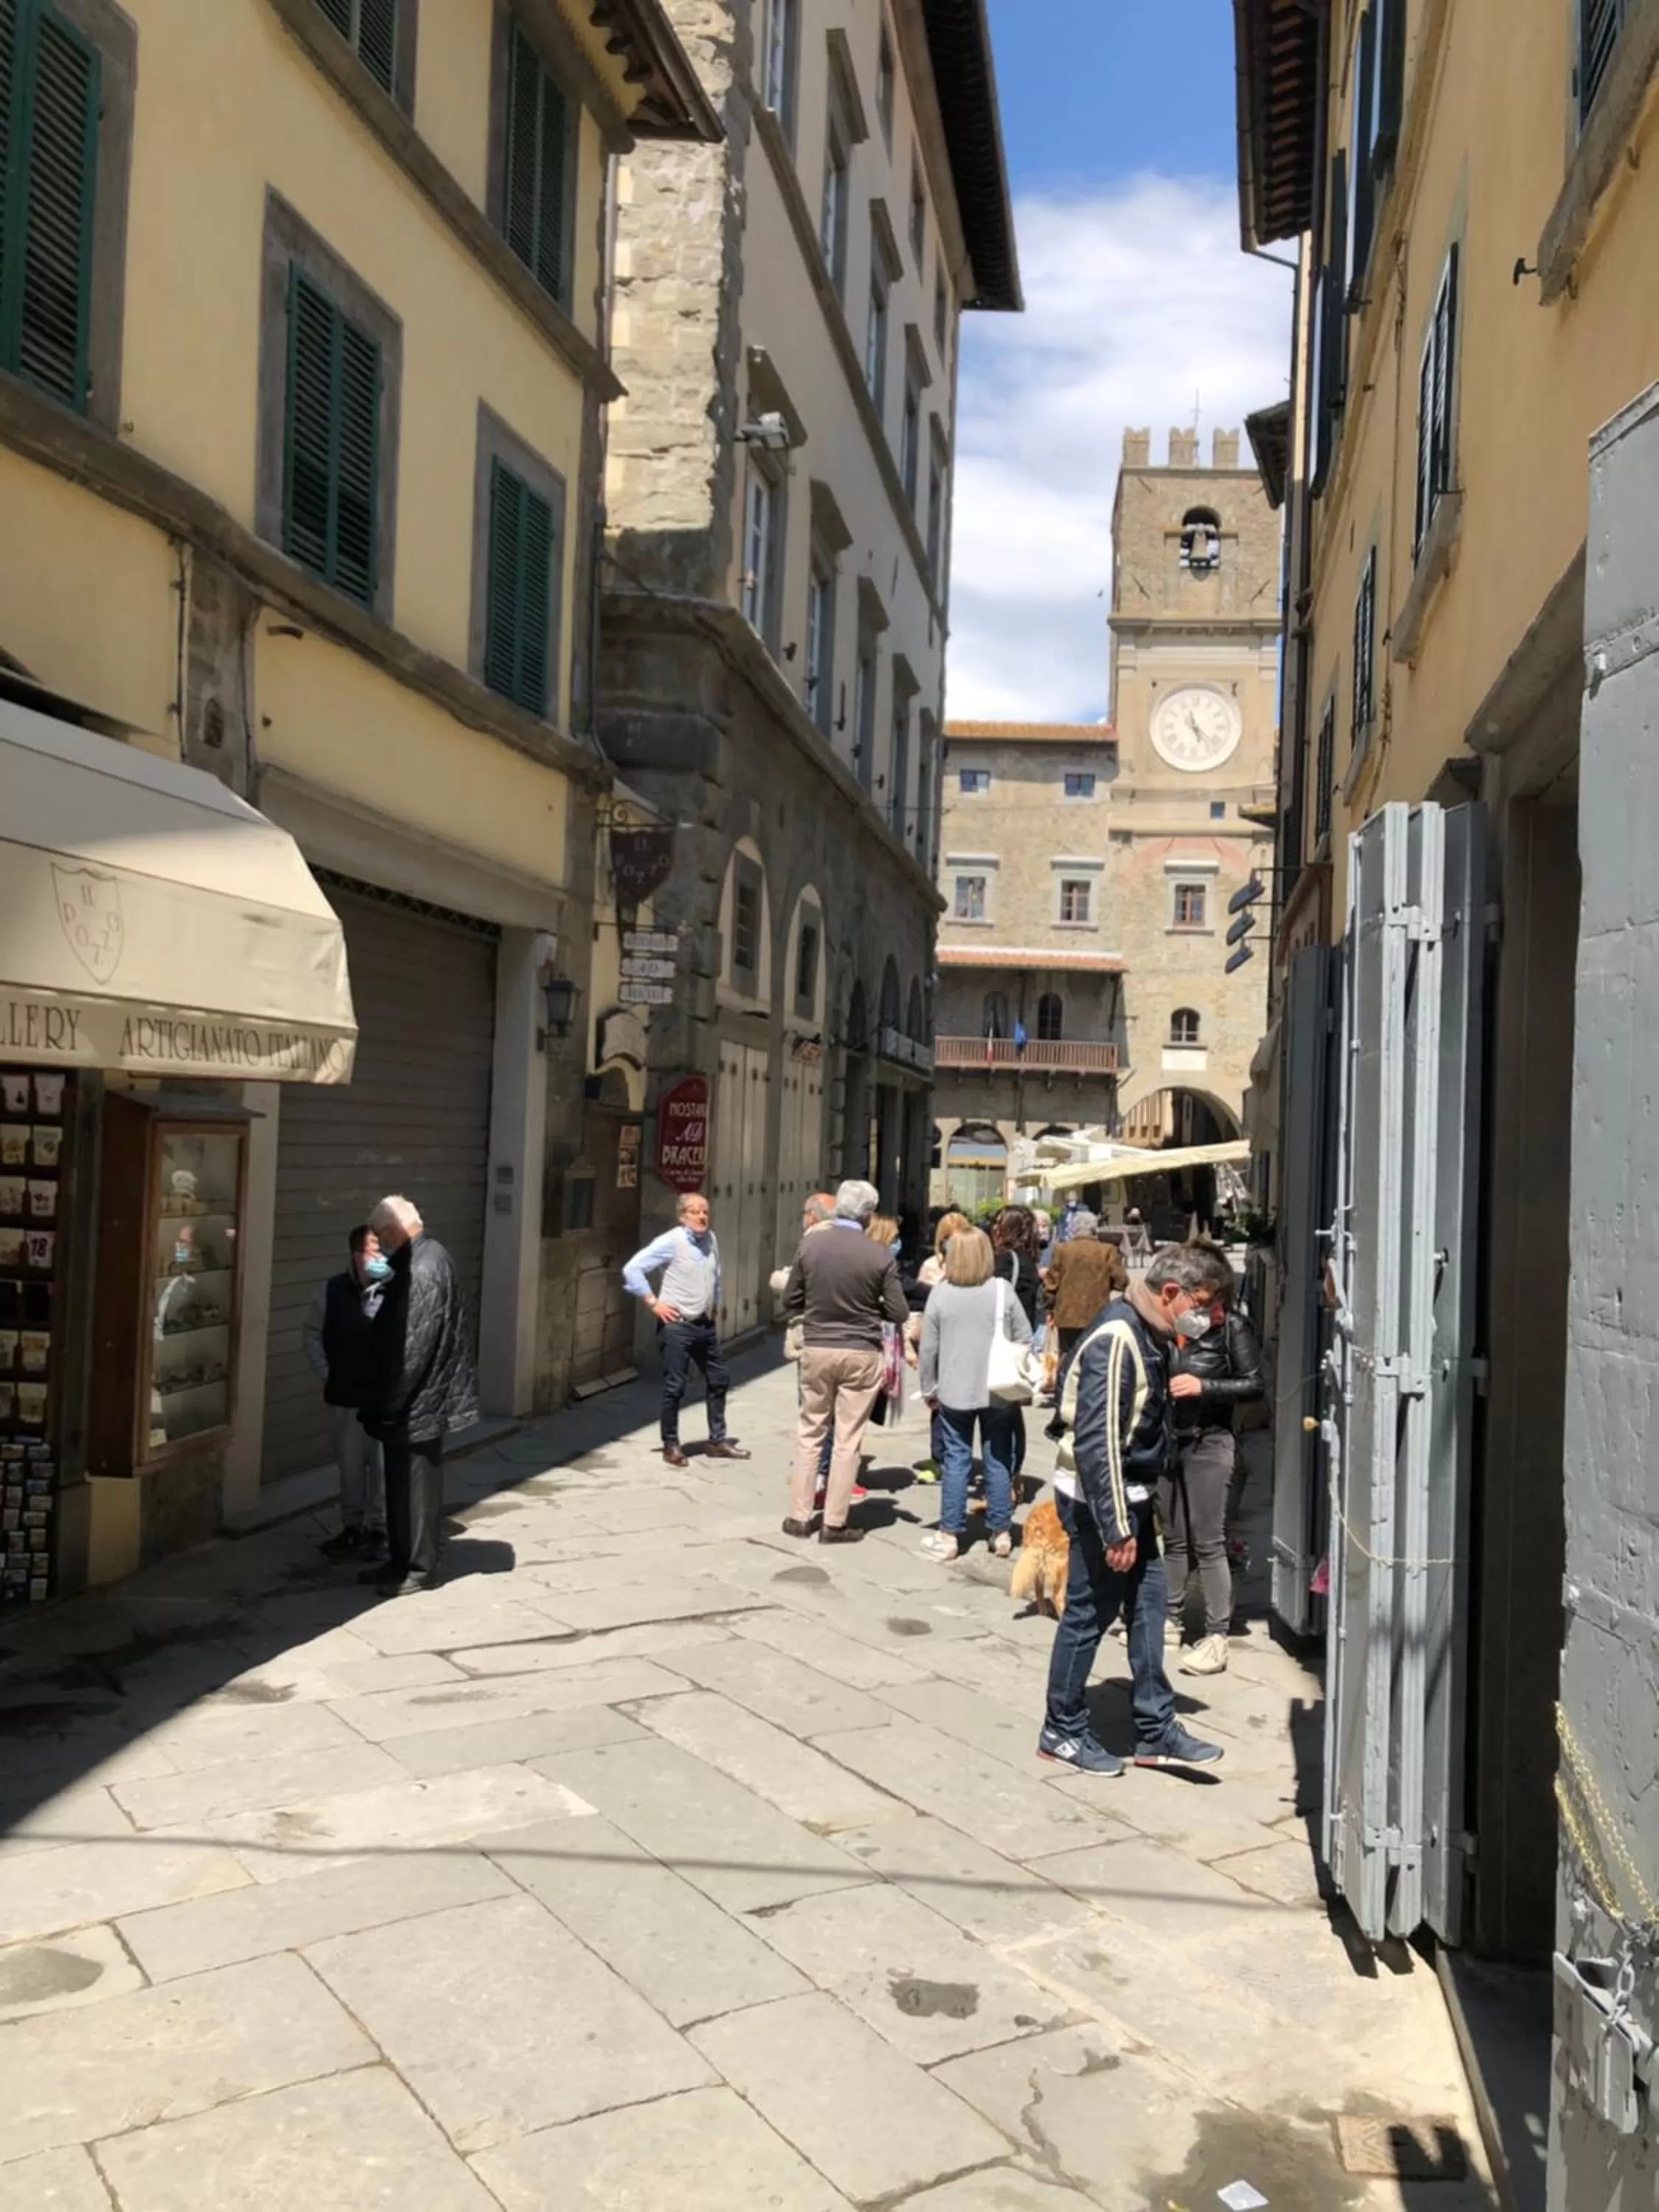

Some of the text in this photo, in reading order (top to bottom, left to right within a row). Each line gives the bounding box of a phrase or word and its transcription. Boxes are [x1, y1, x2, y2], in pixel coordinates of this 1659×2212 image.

[81, 884, 95, 907] IL
[0, 1001, 347, 1074] LERY ARTIGIANATO ITALIANO
